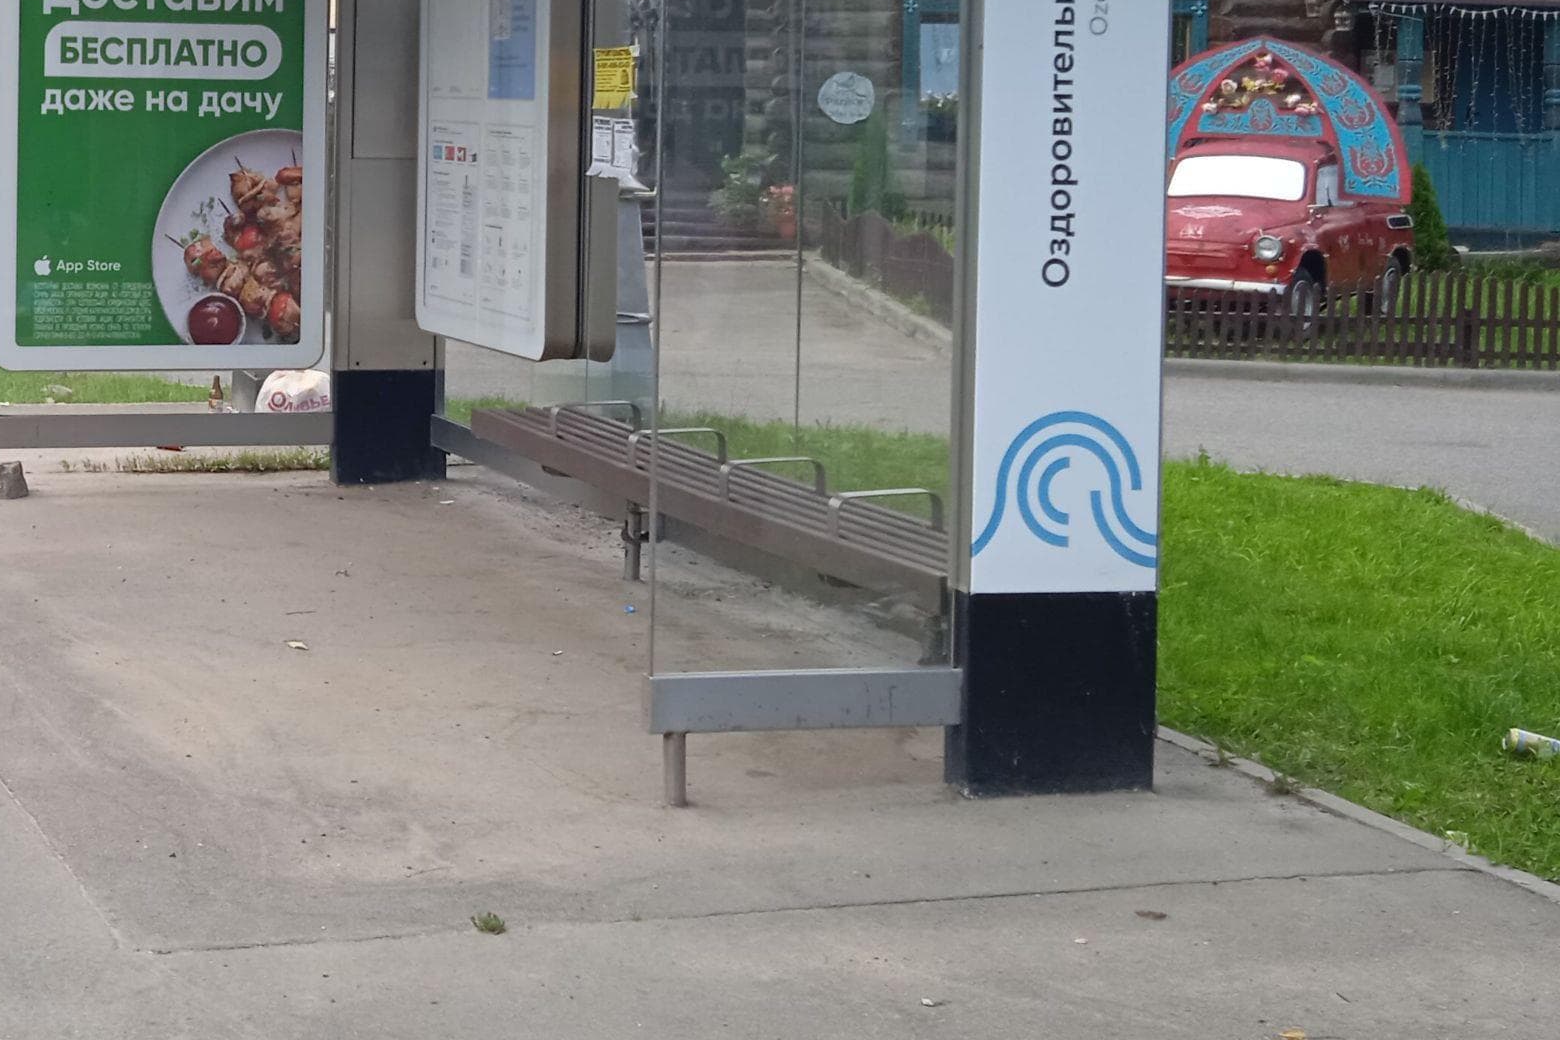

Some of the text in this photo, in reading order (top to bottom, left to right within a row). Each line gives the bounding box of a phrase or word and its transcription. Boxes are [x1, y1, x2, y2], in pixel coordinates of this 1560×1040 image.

[59, 36, 268, 68] БЕСПЛАТНО
[40, 88, 284, 121] даже на дачу
[56, 259, 122, 274] App Store
